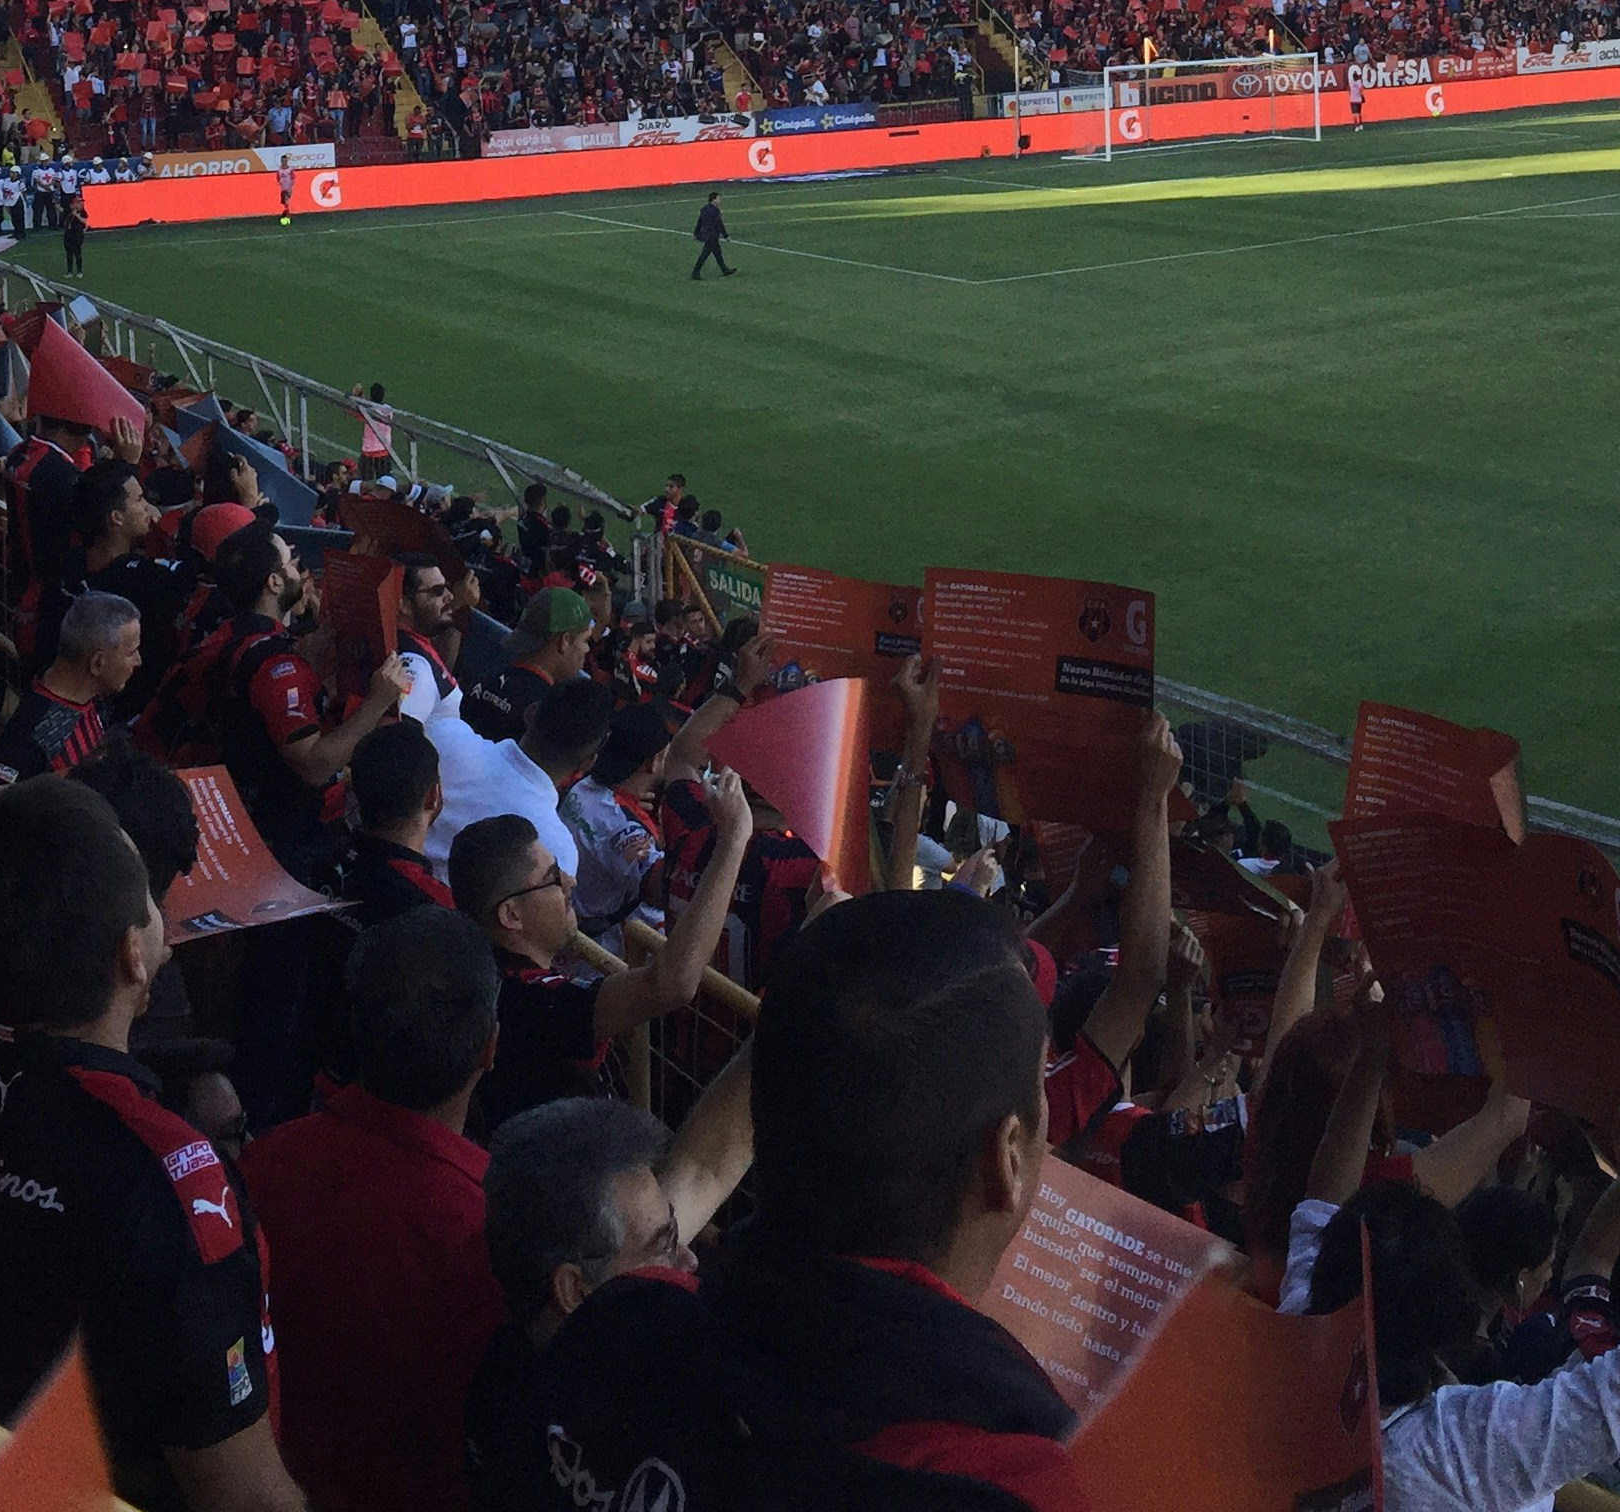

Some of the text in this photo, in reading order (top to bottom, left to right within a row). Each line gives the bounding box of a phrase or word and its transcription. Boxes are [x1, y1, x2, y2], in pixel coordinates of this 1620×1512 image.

[1263, 70, 1337, 93] TOYOTA
[636, 119, 670, 131] DIARIO
[159, 158, 251, 178] AHORRO
[709, 567, 763, 606] SALIDA
[164, 1141, 211, 1167] GRUPO
[1031, 1208, 1164, 1290] equipo que siempre
[1038, 1184, 1193, 1279] Hoy GATORADE se une
[1022, 1226, 1082, 1265] buscado
[1080, 1266, 1102, 1285] ser
[1104, 1279, 1118, 1293] el
[1012, 1252, 1130, 1332] El mejor dentro y
[1002, 1284, 1120, 1363] Dando todo hasta
[1049, 1358, 1090, 1387] veces
